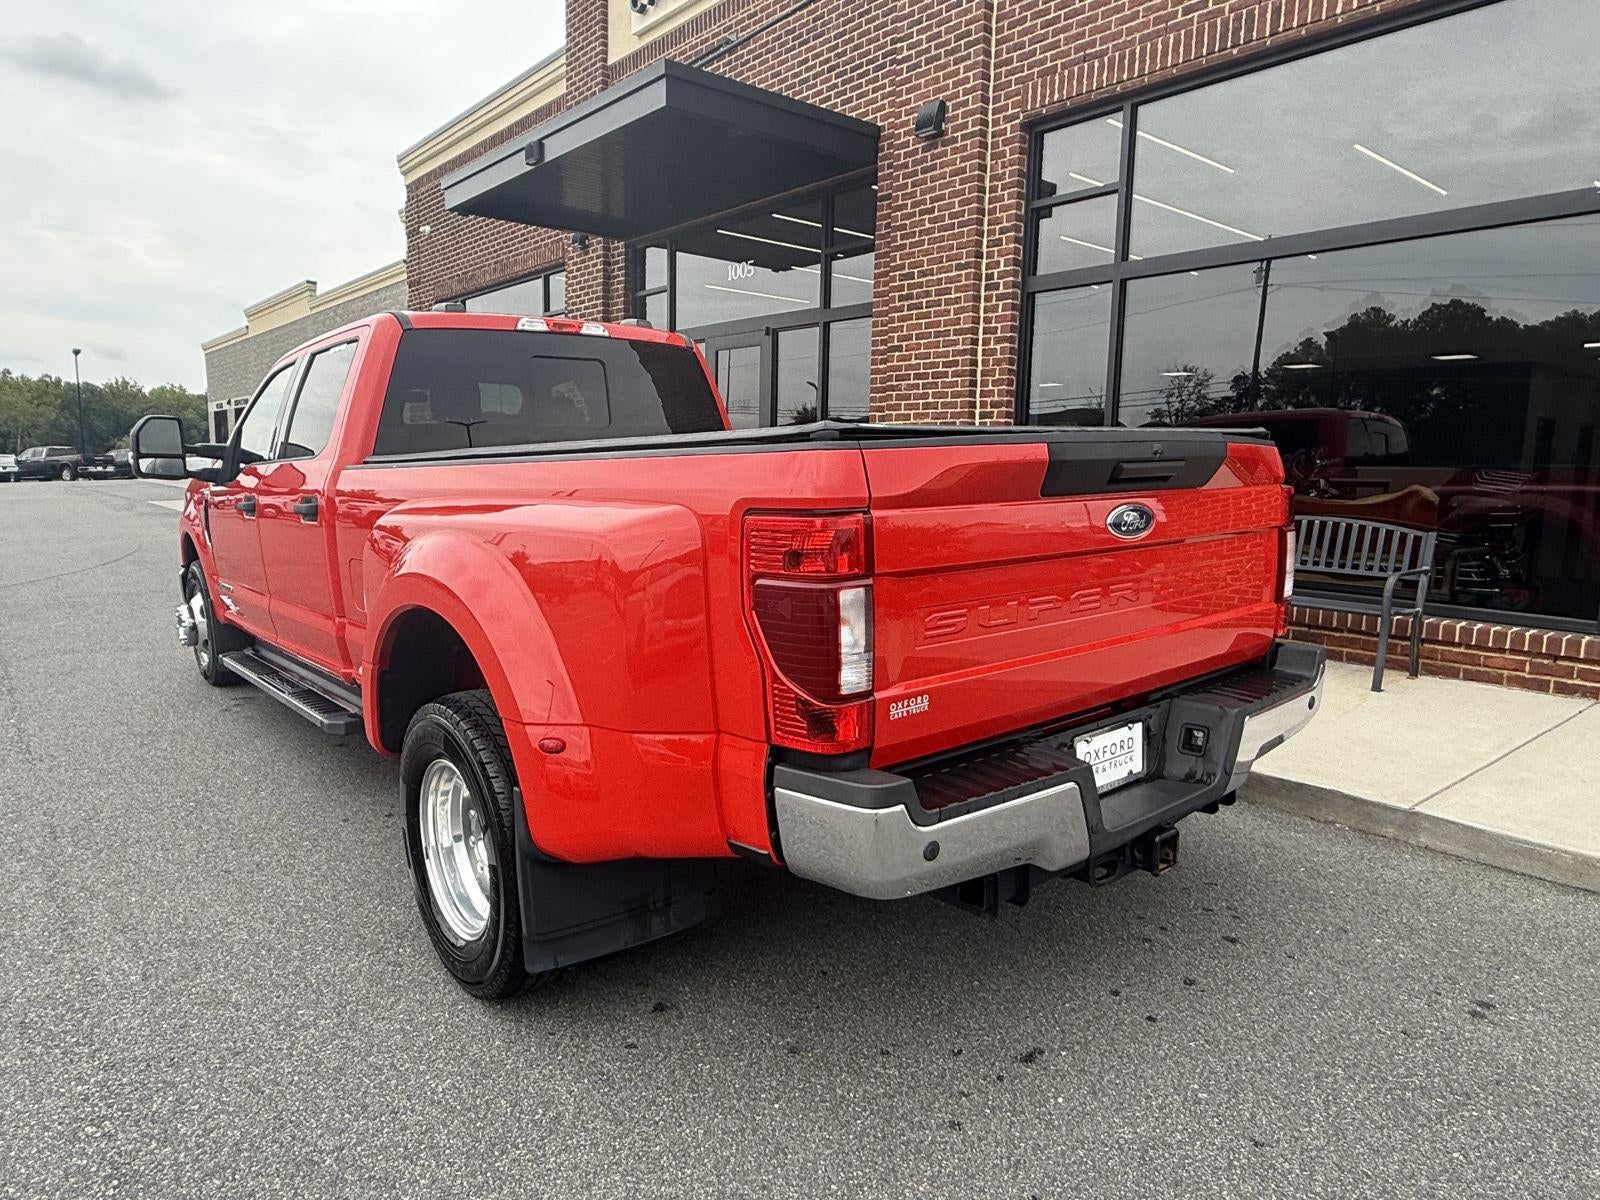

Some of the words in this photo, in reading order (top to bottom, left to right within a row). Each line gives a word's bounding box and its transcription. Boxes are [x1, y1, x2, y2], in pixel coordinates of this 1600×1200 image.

[727, 260, 754, 281] 1005
[1121, 511, 1146, 531] Ford
[923, 582, 1140, 640] SUPER
[890, 694, 929, 711] OXFORD
[890, 712, 902, 720] CAR
[909, 705, 929, 715] TRUCK
[1083, 737, 1135, 764] OXFORD
[1101, 764, 1107, 773] &
[1109, 755, 1134, 770] TRUCK
